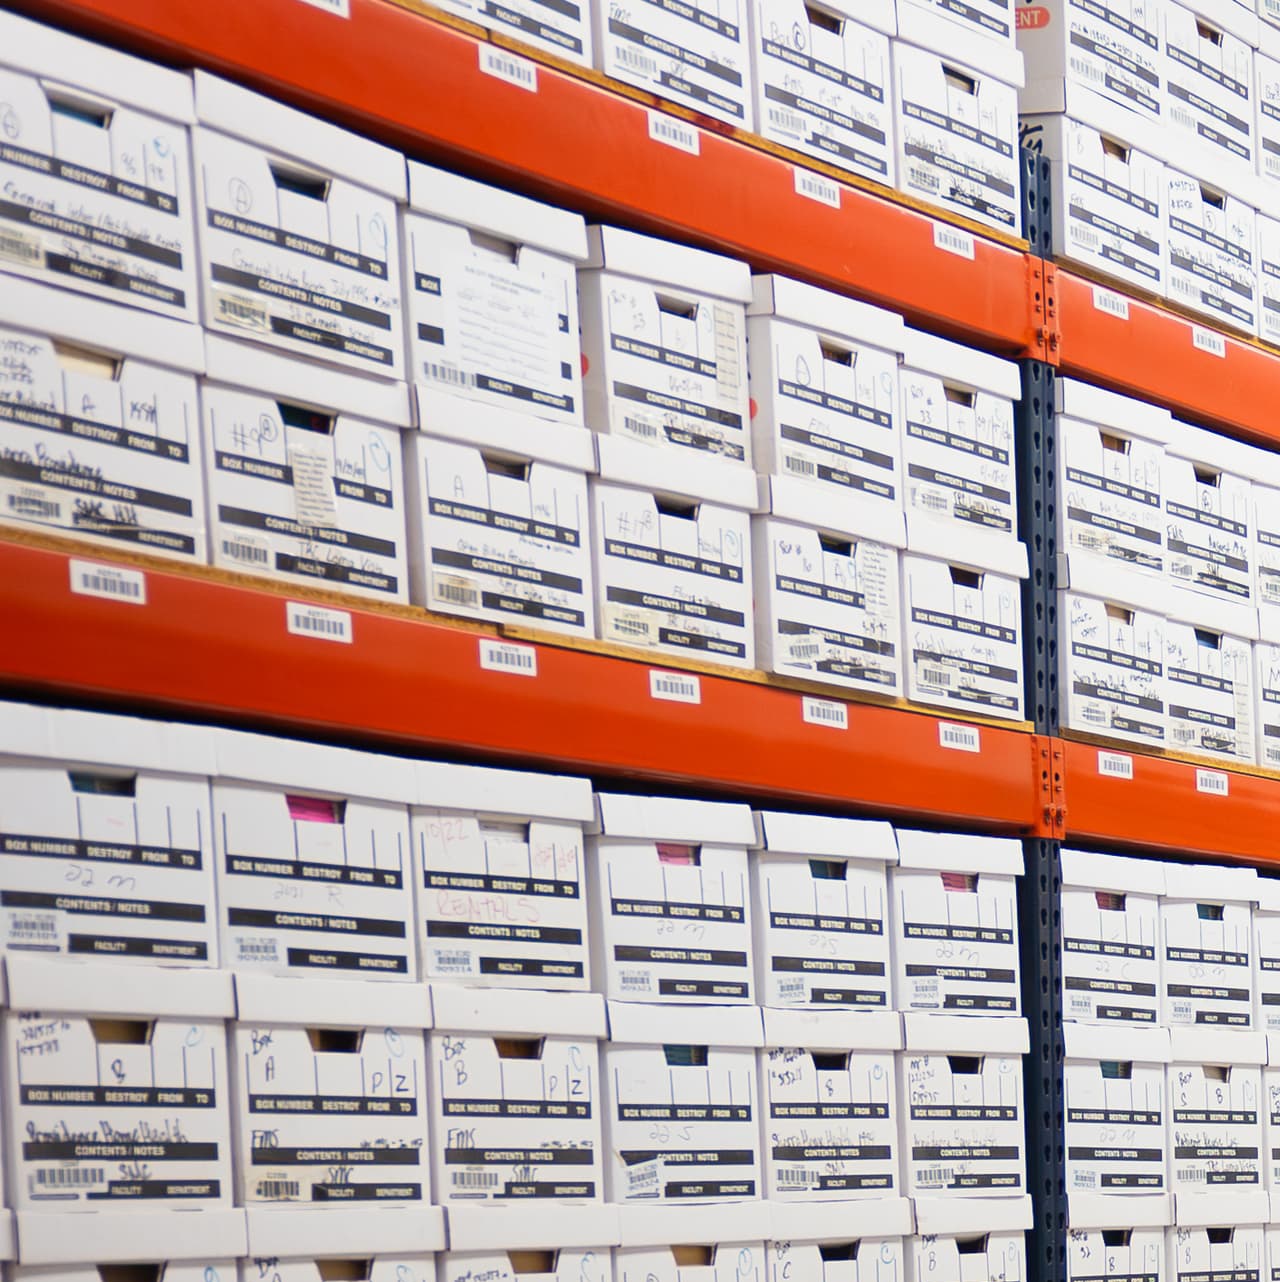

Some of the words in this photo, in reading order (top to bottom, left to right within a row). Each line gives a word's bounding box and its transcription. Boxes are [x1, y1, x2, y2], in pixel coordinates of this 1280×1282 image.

[214, 214, 234, 229] BOX
[237, 221, 276, 242] NUMBER
[285, 236, 325, 256] DESTROY
[335, 252, 359, 267] FROM
[369, 262, 382, 274] TO
[431, 876, 448, 885] BOX
[451, 877, 484, 887] NUMBER
[493, 880, 526, 890] DESTROY
[534, 884, 554, 892] FROM
[563, 885, 574, 894] TO
[437, 888, 541, 922] RENTALS
[468, 926, 510, 936] CONTENTS
[517, 929, 540, 938] NOTES
[396, 1075, 409, 1092] Z
